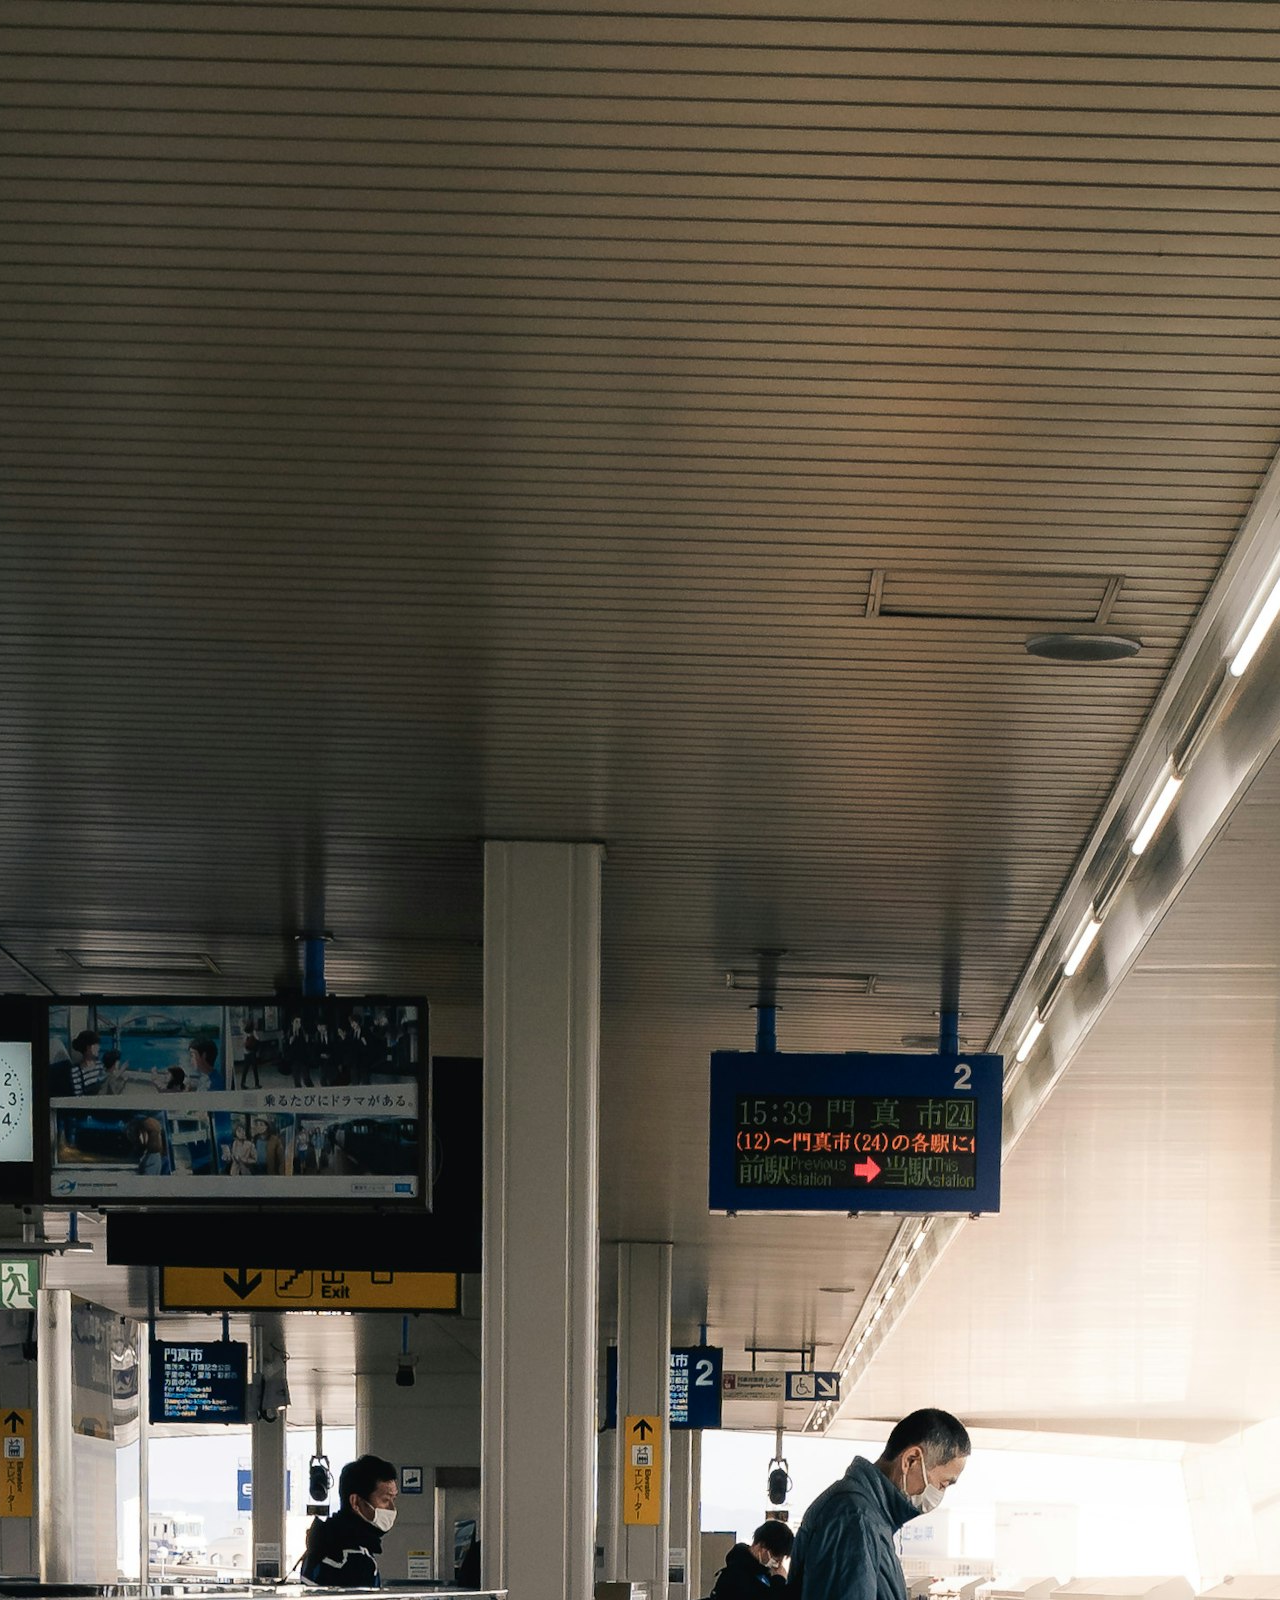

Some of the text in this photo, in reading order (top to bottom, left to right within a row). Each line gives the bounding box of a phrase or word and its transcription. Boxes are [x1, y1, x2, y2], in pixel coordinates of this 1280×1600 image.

[4, 1072, 12, 1086] 2
[953, 1063, 972, 1090] 2
[8, 1092, 17, 1106] 3
[264, 1094, 414, 1108] 乗るたびにドラマがある。
[2, 1112, 11, 1126] 4
[739, 1101, 812, 1126] 15:39
[949, 1104, 971, 1127] 24
[739, 1154, 790, 1185] 前駅
[790, 1157, 847, 1172] Previous
[884, 1155, 932, 1186] 当駅
[931, 1158, 959, 1173] This
[790, 1173, 832, 1187] station
[932, 1174, 975, 1188] station
[321, 1285, 350, 1299] Exit
[164, 1347, 203, 1362] 門真市
[695, 1359, 714, 1387] 2
[7, 1461, 16, 1512] エレベーター
[634, 1468, 643, 1520] エレベーター
